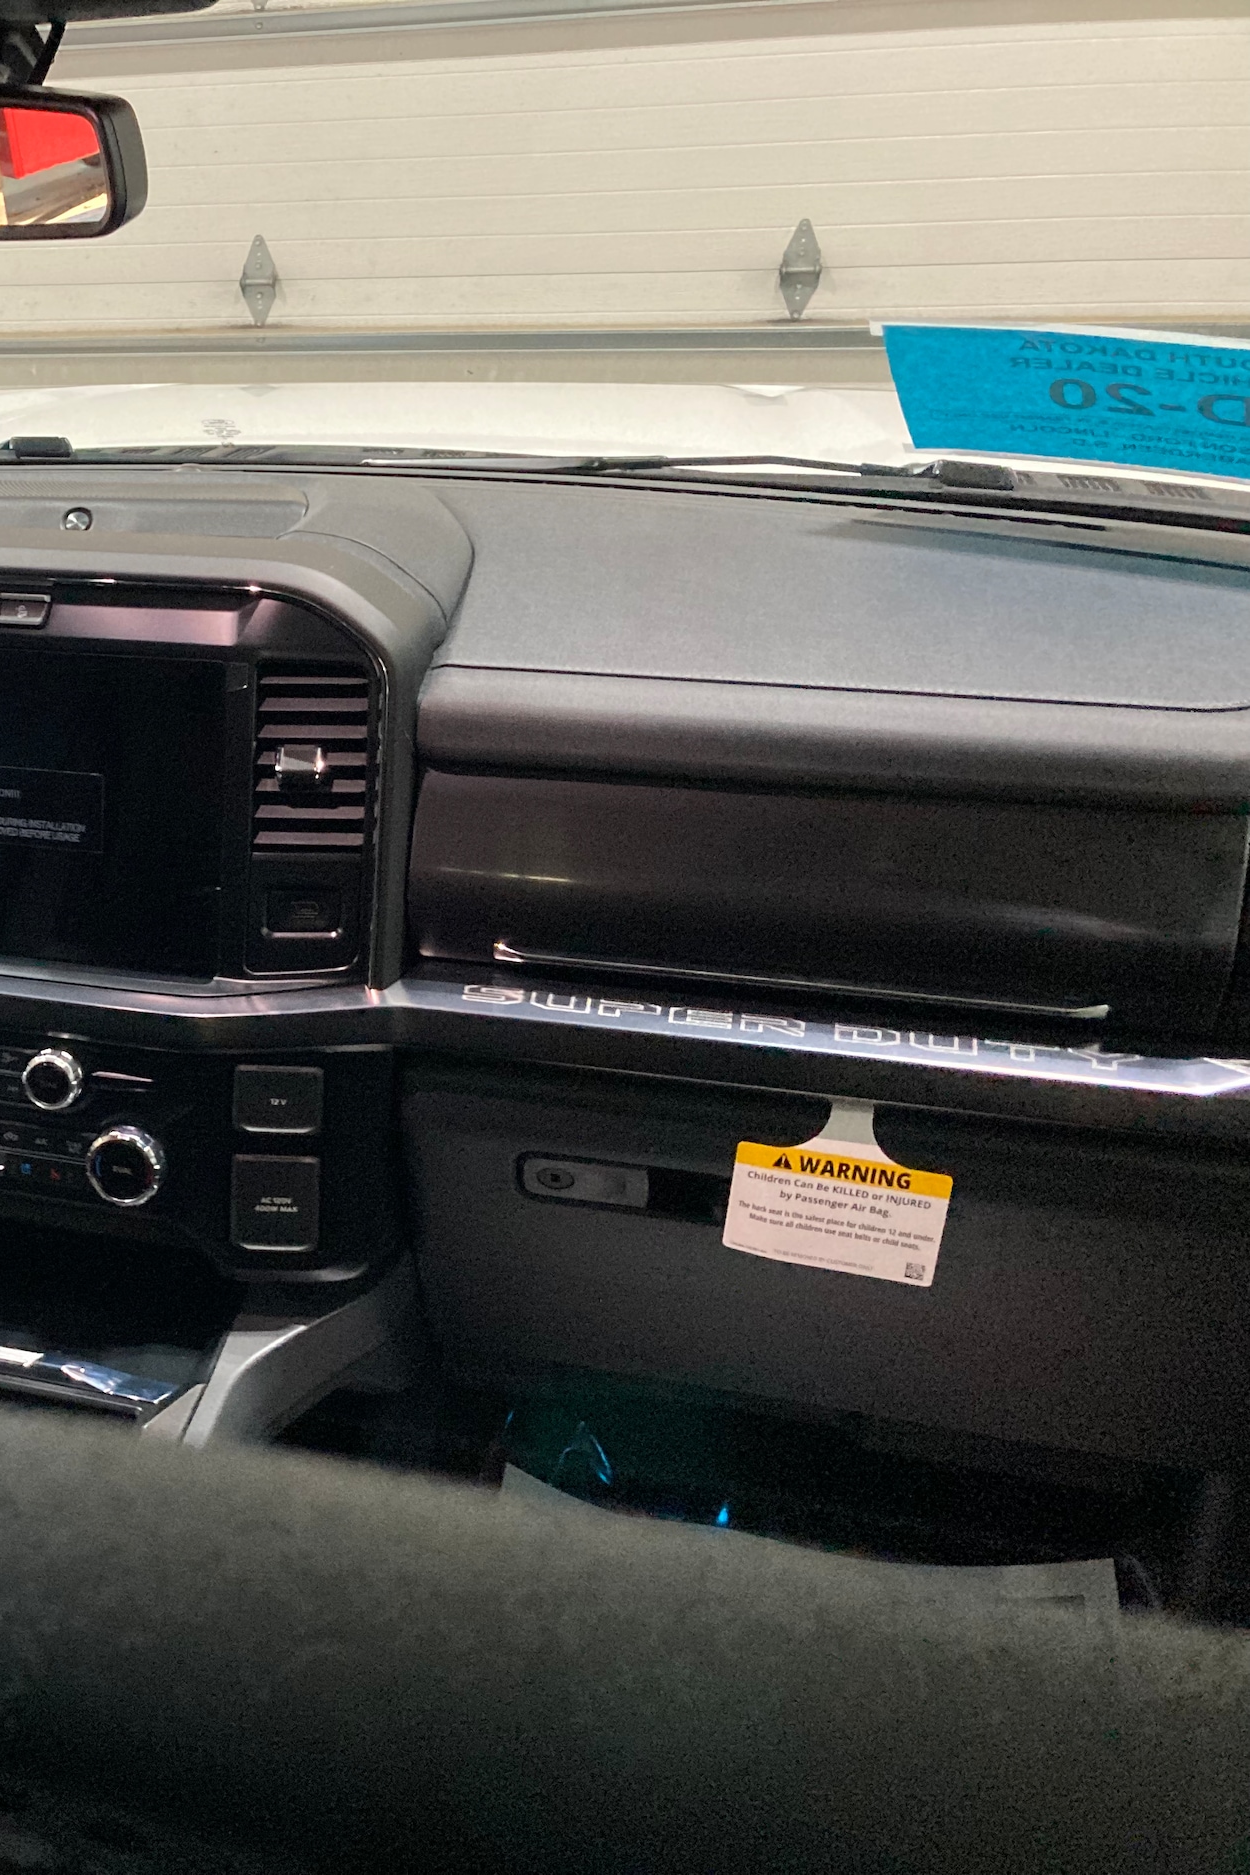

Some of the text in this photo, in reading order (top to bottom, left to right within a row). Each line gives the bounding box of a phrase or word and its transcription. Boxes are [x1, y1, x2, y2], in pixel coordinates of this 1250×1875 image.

[461, 984, 1144, 1071] SUPER DUTY
[747, 1170, 932, 1210] Children Can Be KILLED or INJURED
[799, 1154, 912, 1190] WARNING
[738, 1200, 751, 1209] The
[768, 1208, 783, 1217] seat
[791, 1211, 804, 1220] the
[805, 1213, 825, 1224] safest
[826, 1217, 845, 1227] place
[846, 1220, 857, 1229] for
[858, 1222, 887, 1234] children
[888, 1228, 897, 1237] 12
[897, 1230, 912, 1239] and
[779, 1190, 892, 1218] by Passenger Air Bag.
[748, 1213, 768, 1223] Make
[769, 1218, 784, 1227] sure
[785, 1221, 794, 1229] all
[795, 1222, 823, 1234] children
[824, 1228, 837, 1236] use
[837, 1230, 853, 1239] seat
[881, 1238, 900, 1248] child
